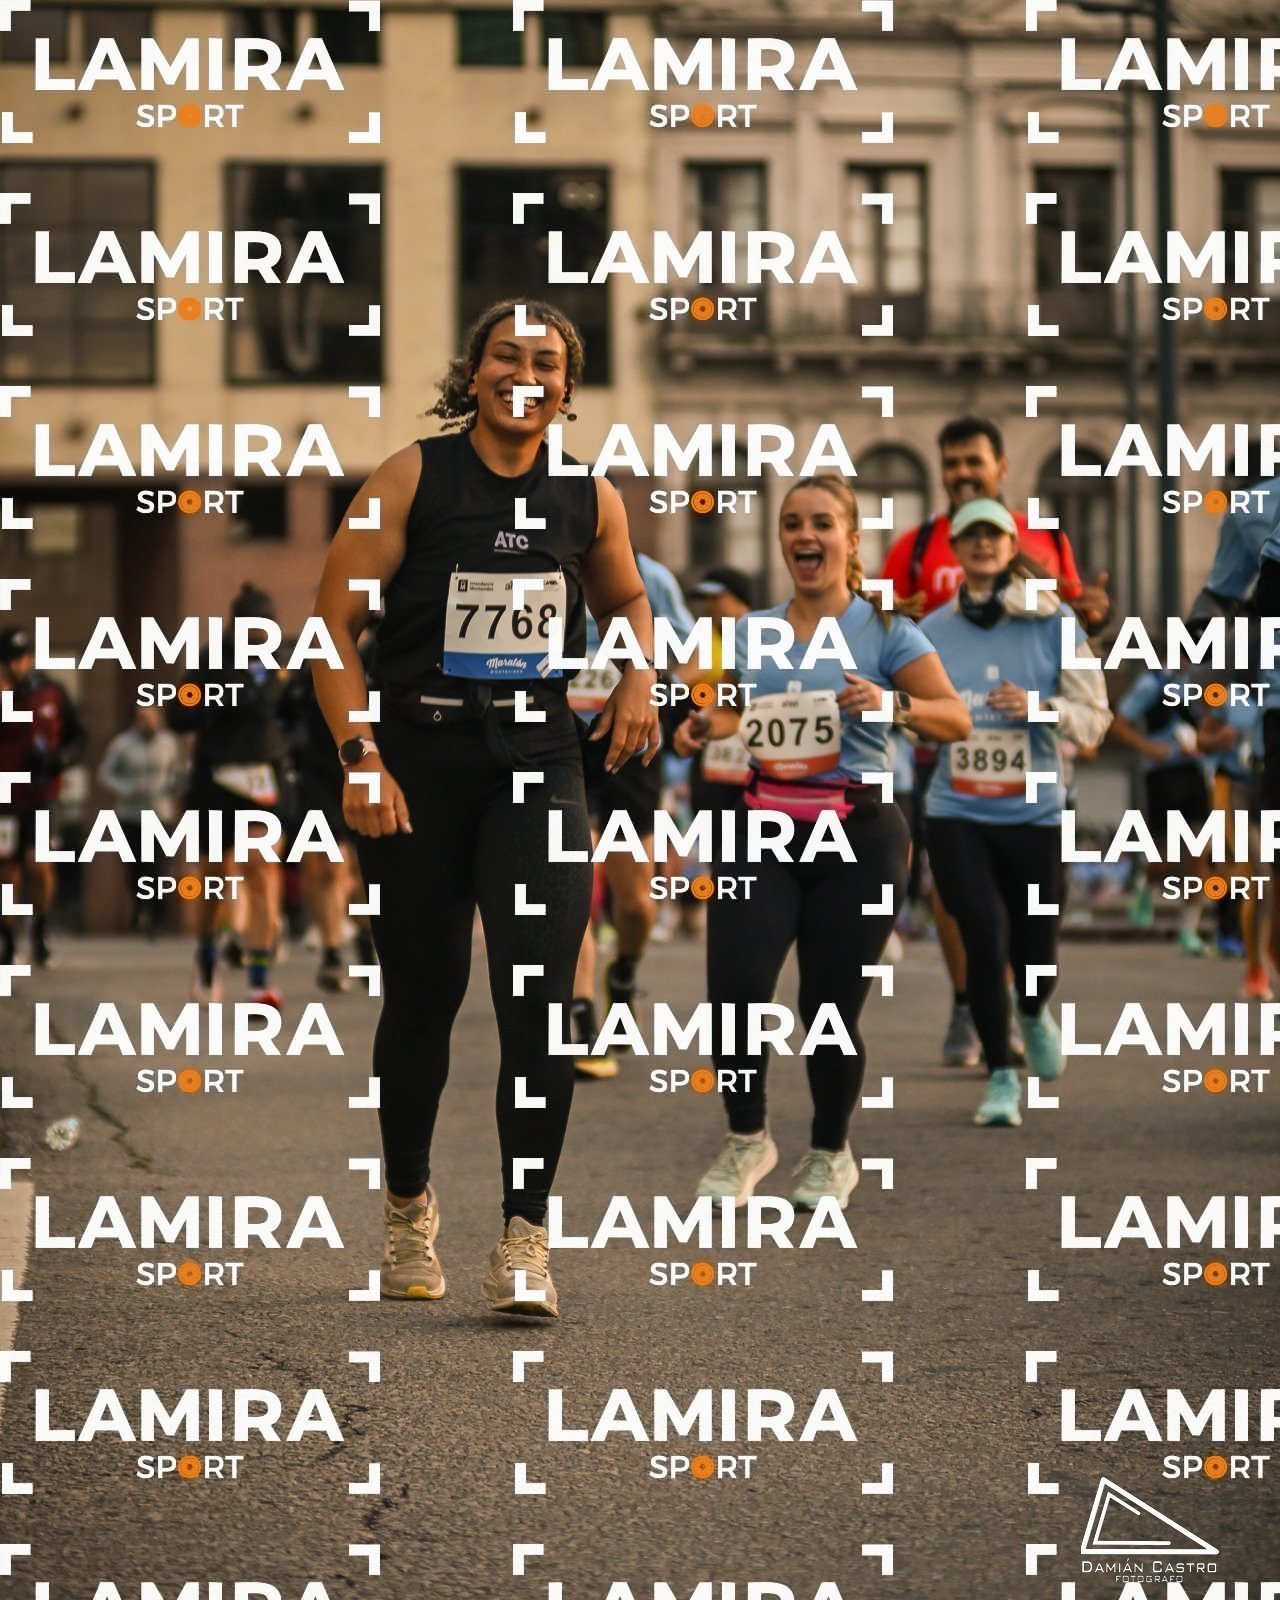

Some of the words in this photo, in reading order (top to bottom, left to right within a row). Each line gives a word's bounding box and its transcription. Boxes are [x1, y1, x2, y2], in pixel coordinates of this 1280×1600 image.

[494, 530, 529, 550] ATC
[456, 603, 557, 640] 7768
[486, 657, 527, 669] Maratón
[746, 715, 834, 747] 2075
[957, 747, 1025, 772] 3894
